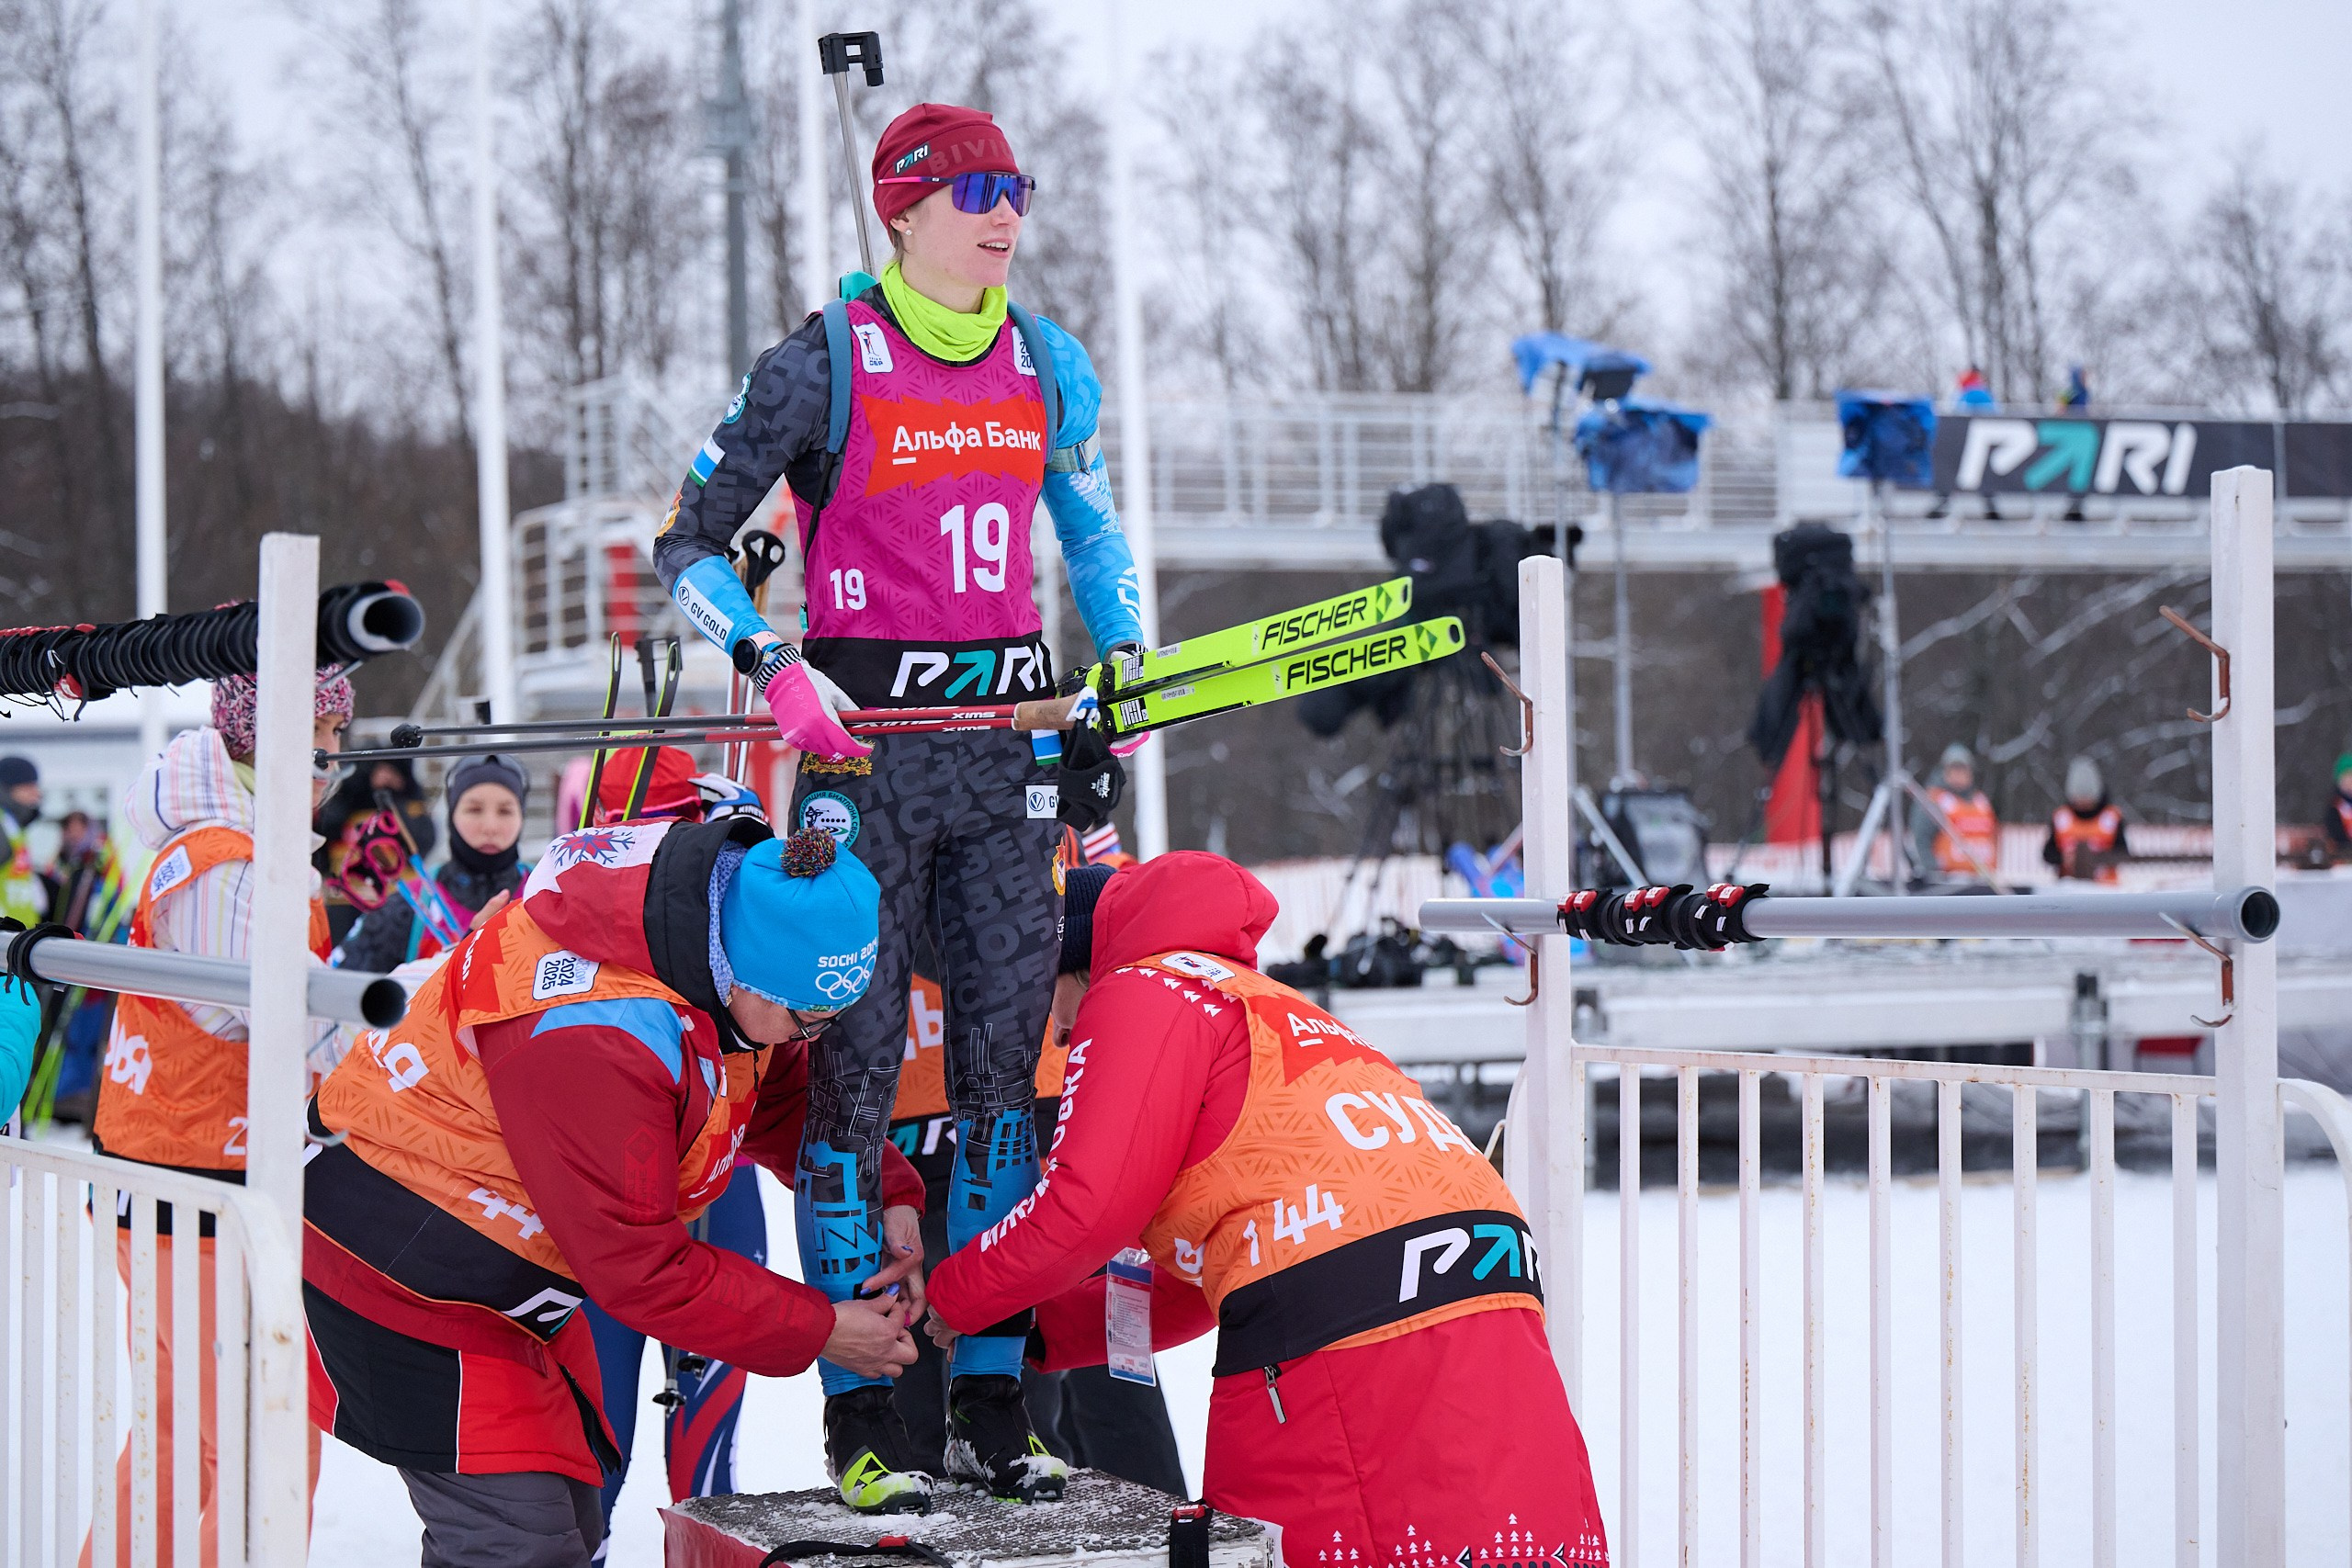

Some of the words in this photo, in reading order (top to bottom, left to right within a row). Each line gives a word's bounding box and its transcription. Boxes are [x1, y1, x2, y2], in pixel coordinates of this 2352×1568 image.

[896, 144, 928, 174] PARI
[892, 422, 982, 456] Альфа
[985, 421, 1041, 451] Банк
[1957, 422, 2197, 494] PARI
[940, 502, 1010, 593] 19
[830, 568, 866, 611] 19
[690, 602, 704, 619] GV
[703, 614, 727, 640] GOLD
[1261, 596, 1367, 650] FISCHER
[889, 641, 1047, 699] PARI
[1286, 635, 1407, 690] FISCHER
[541, 960, 560, 990] 2025
[557, 957, 577, 987] 2024
[818, 952, 857, 967] SOCHI
